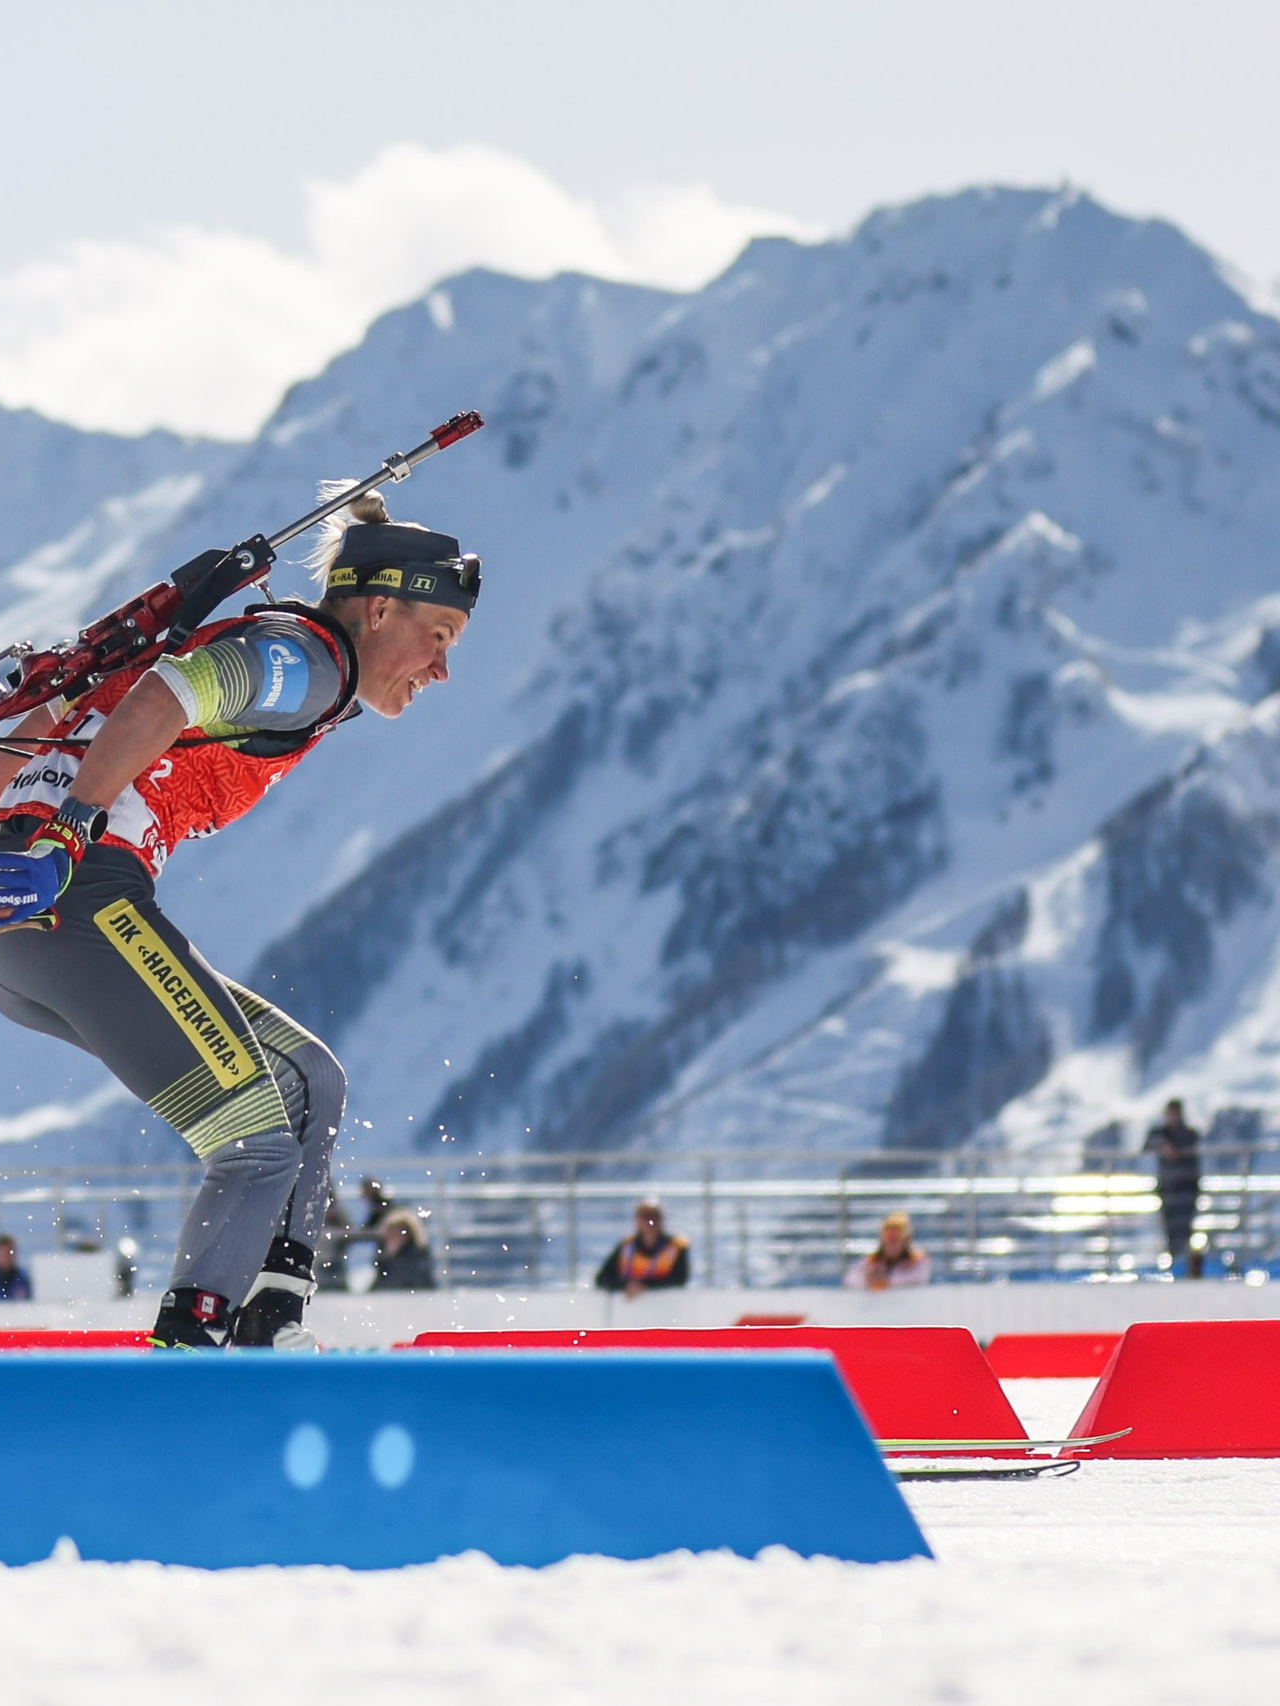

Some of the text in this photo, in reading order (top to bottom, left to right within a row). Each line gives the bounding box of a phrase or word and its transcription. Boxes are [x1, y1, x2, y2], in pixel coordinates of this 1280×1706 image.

[44, 822, 81, 852] LEKI
[108, 913, 240, 1076] ЛК «НАСЕДКИНА»
